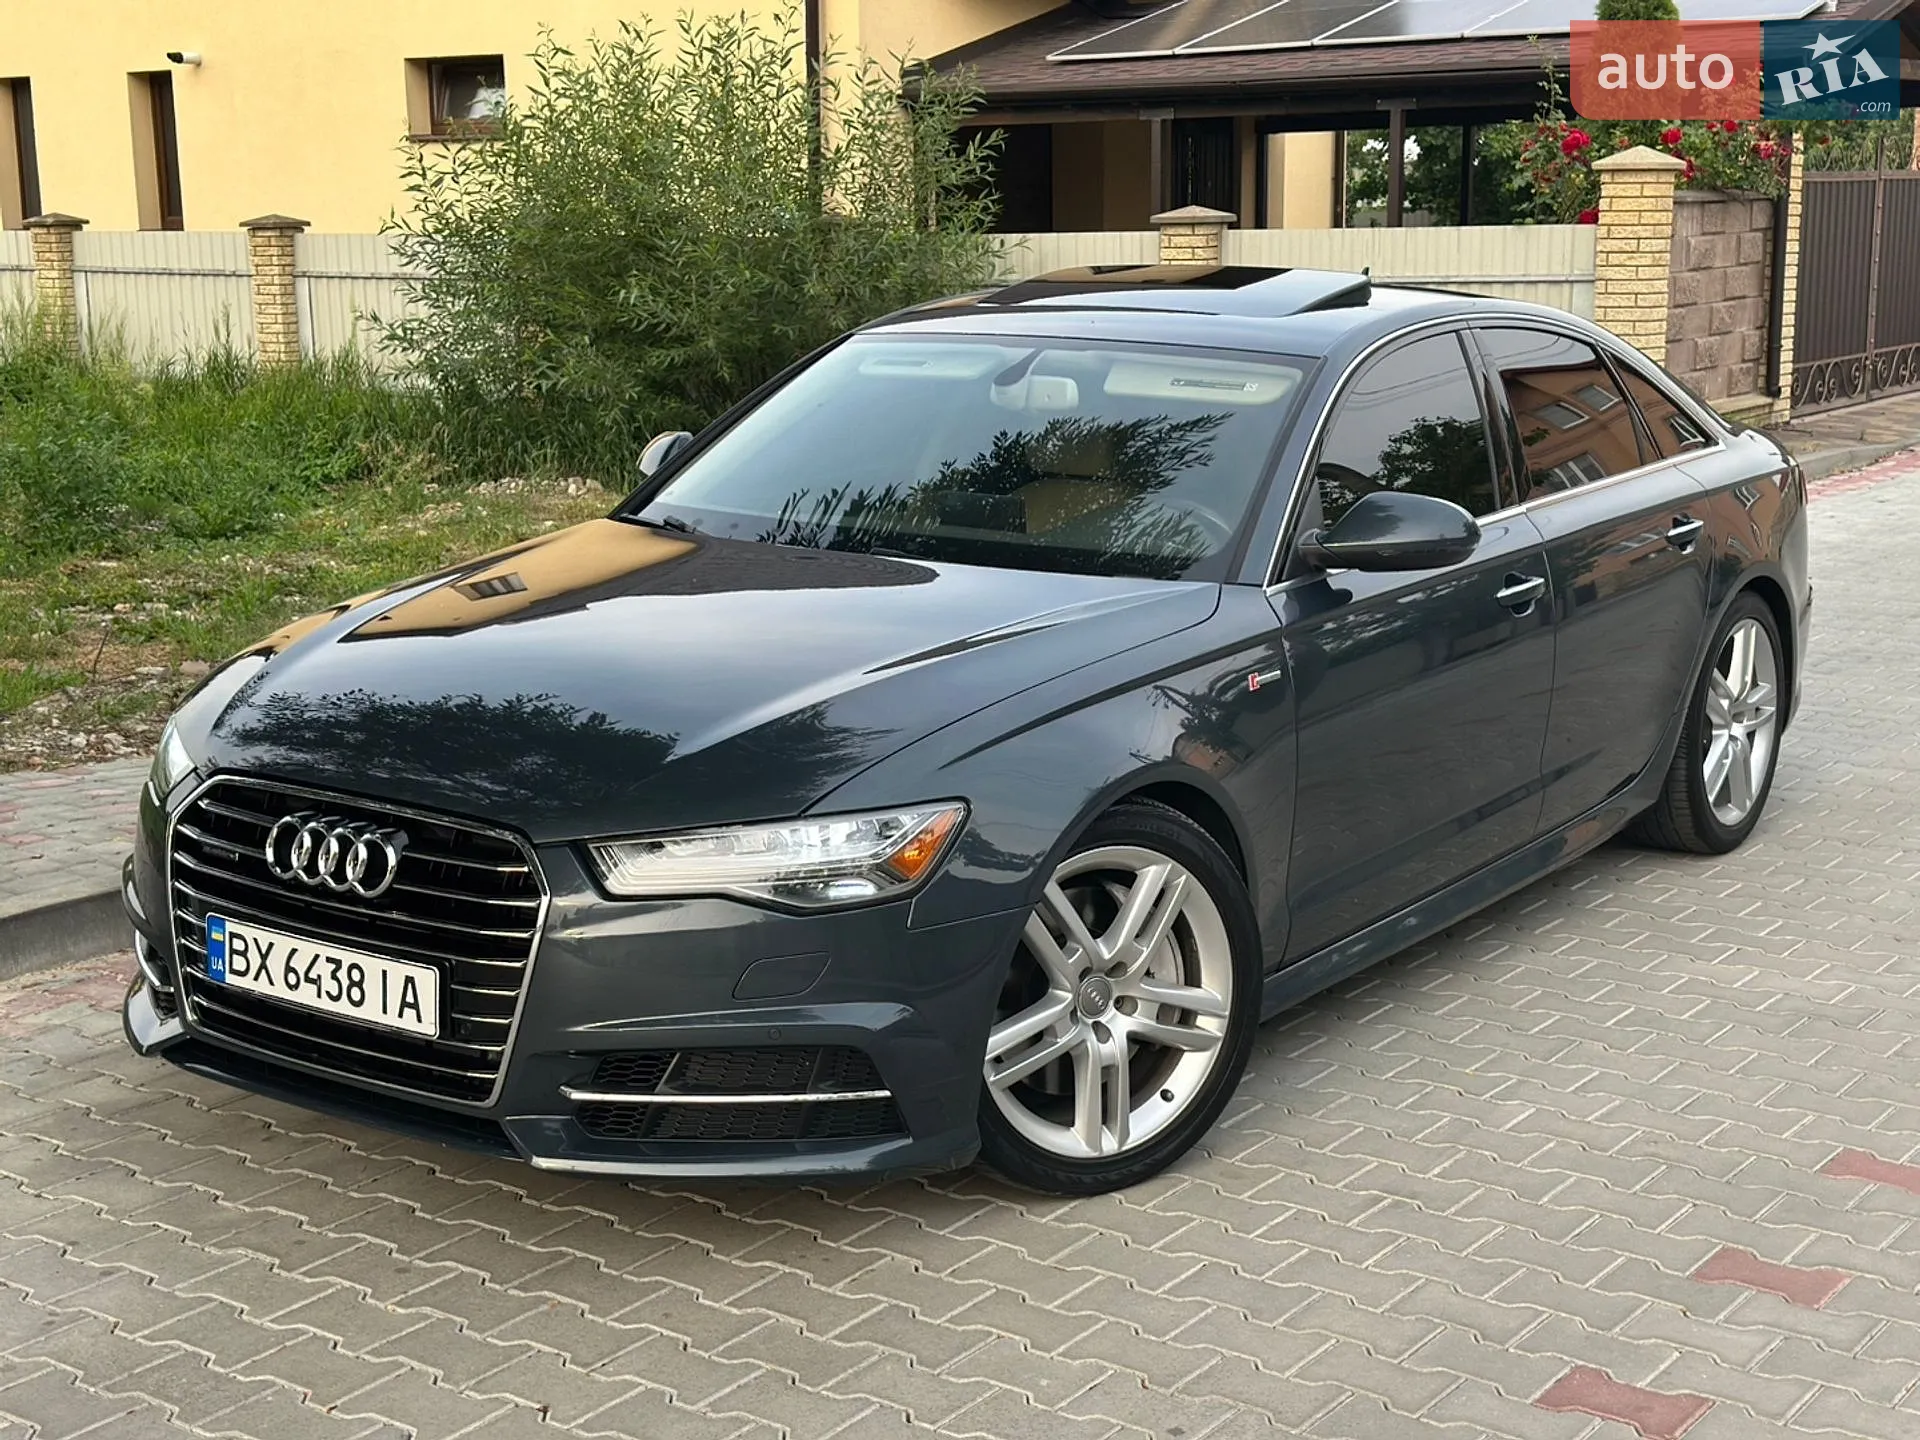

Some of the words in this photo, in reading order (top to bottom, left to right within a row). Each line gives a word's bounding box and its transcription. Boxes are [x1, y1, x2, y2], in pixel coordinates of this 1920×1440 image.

[211, 957, 224, 970] UA
[229, 931, 274, 987] BX
[284, 948, 365, 1008] 6438
[382, 969, 422, 1024] IA
